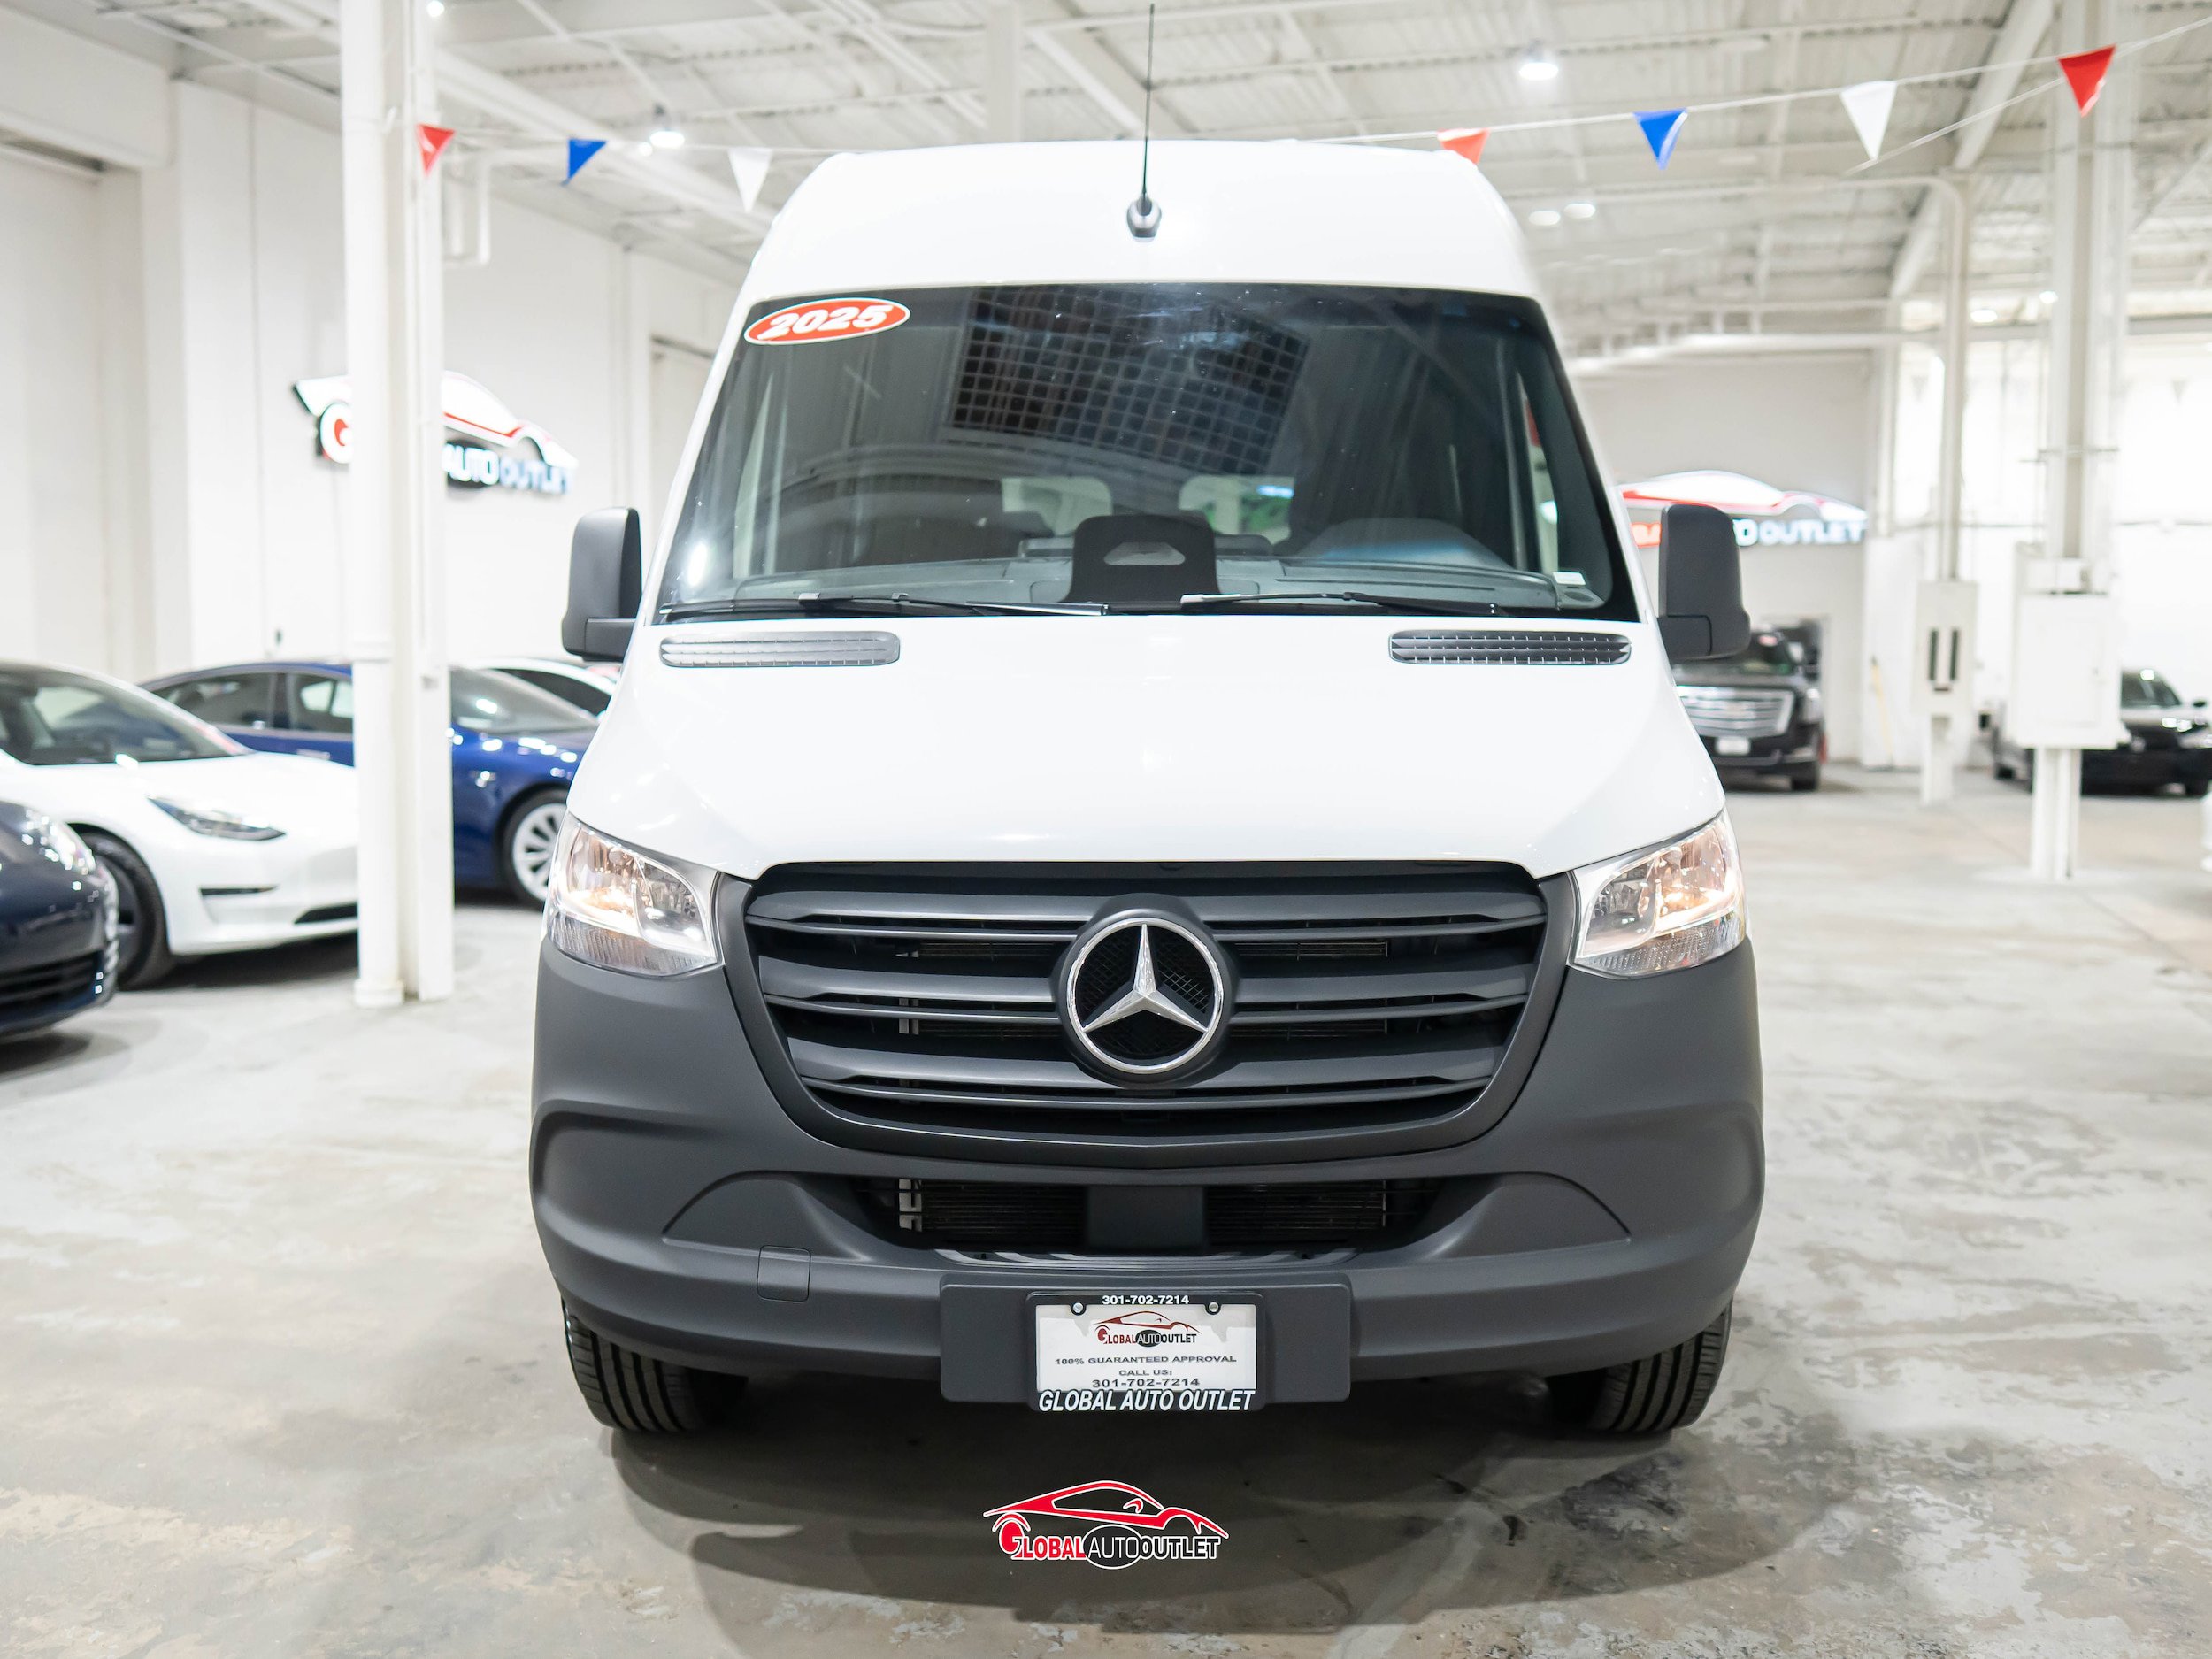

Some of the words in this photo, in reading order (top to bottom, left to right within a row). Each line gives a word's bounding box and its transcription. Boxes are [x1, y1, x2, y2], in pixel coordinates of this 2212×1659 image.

[757, 304, 894, 341] 2025
[1758, 518, 1865, 545] OUTLET
[1102, 1294, 1190, 1305] 301-702-7214
[1087, 1356, 1170, 1364] GUARANTEED
[1092, 1378, 1201, 1388] 301-702-7214
[1038, 1389, 1117, 1412] GLOBAL
[1119, 1389, 1175, 1411] AUTO
[1178, 1389, 1256, 1411] OUTLET
